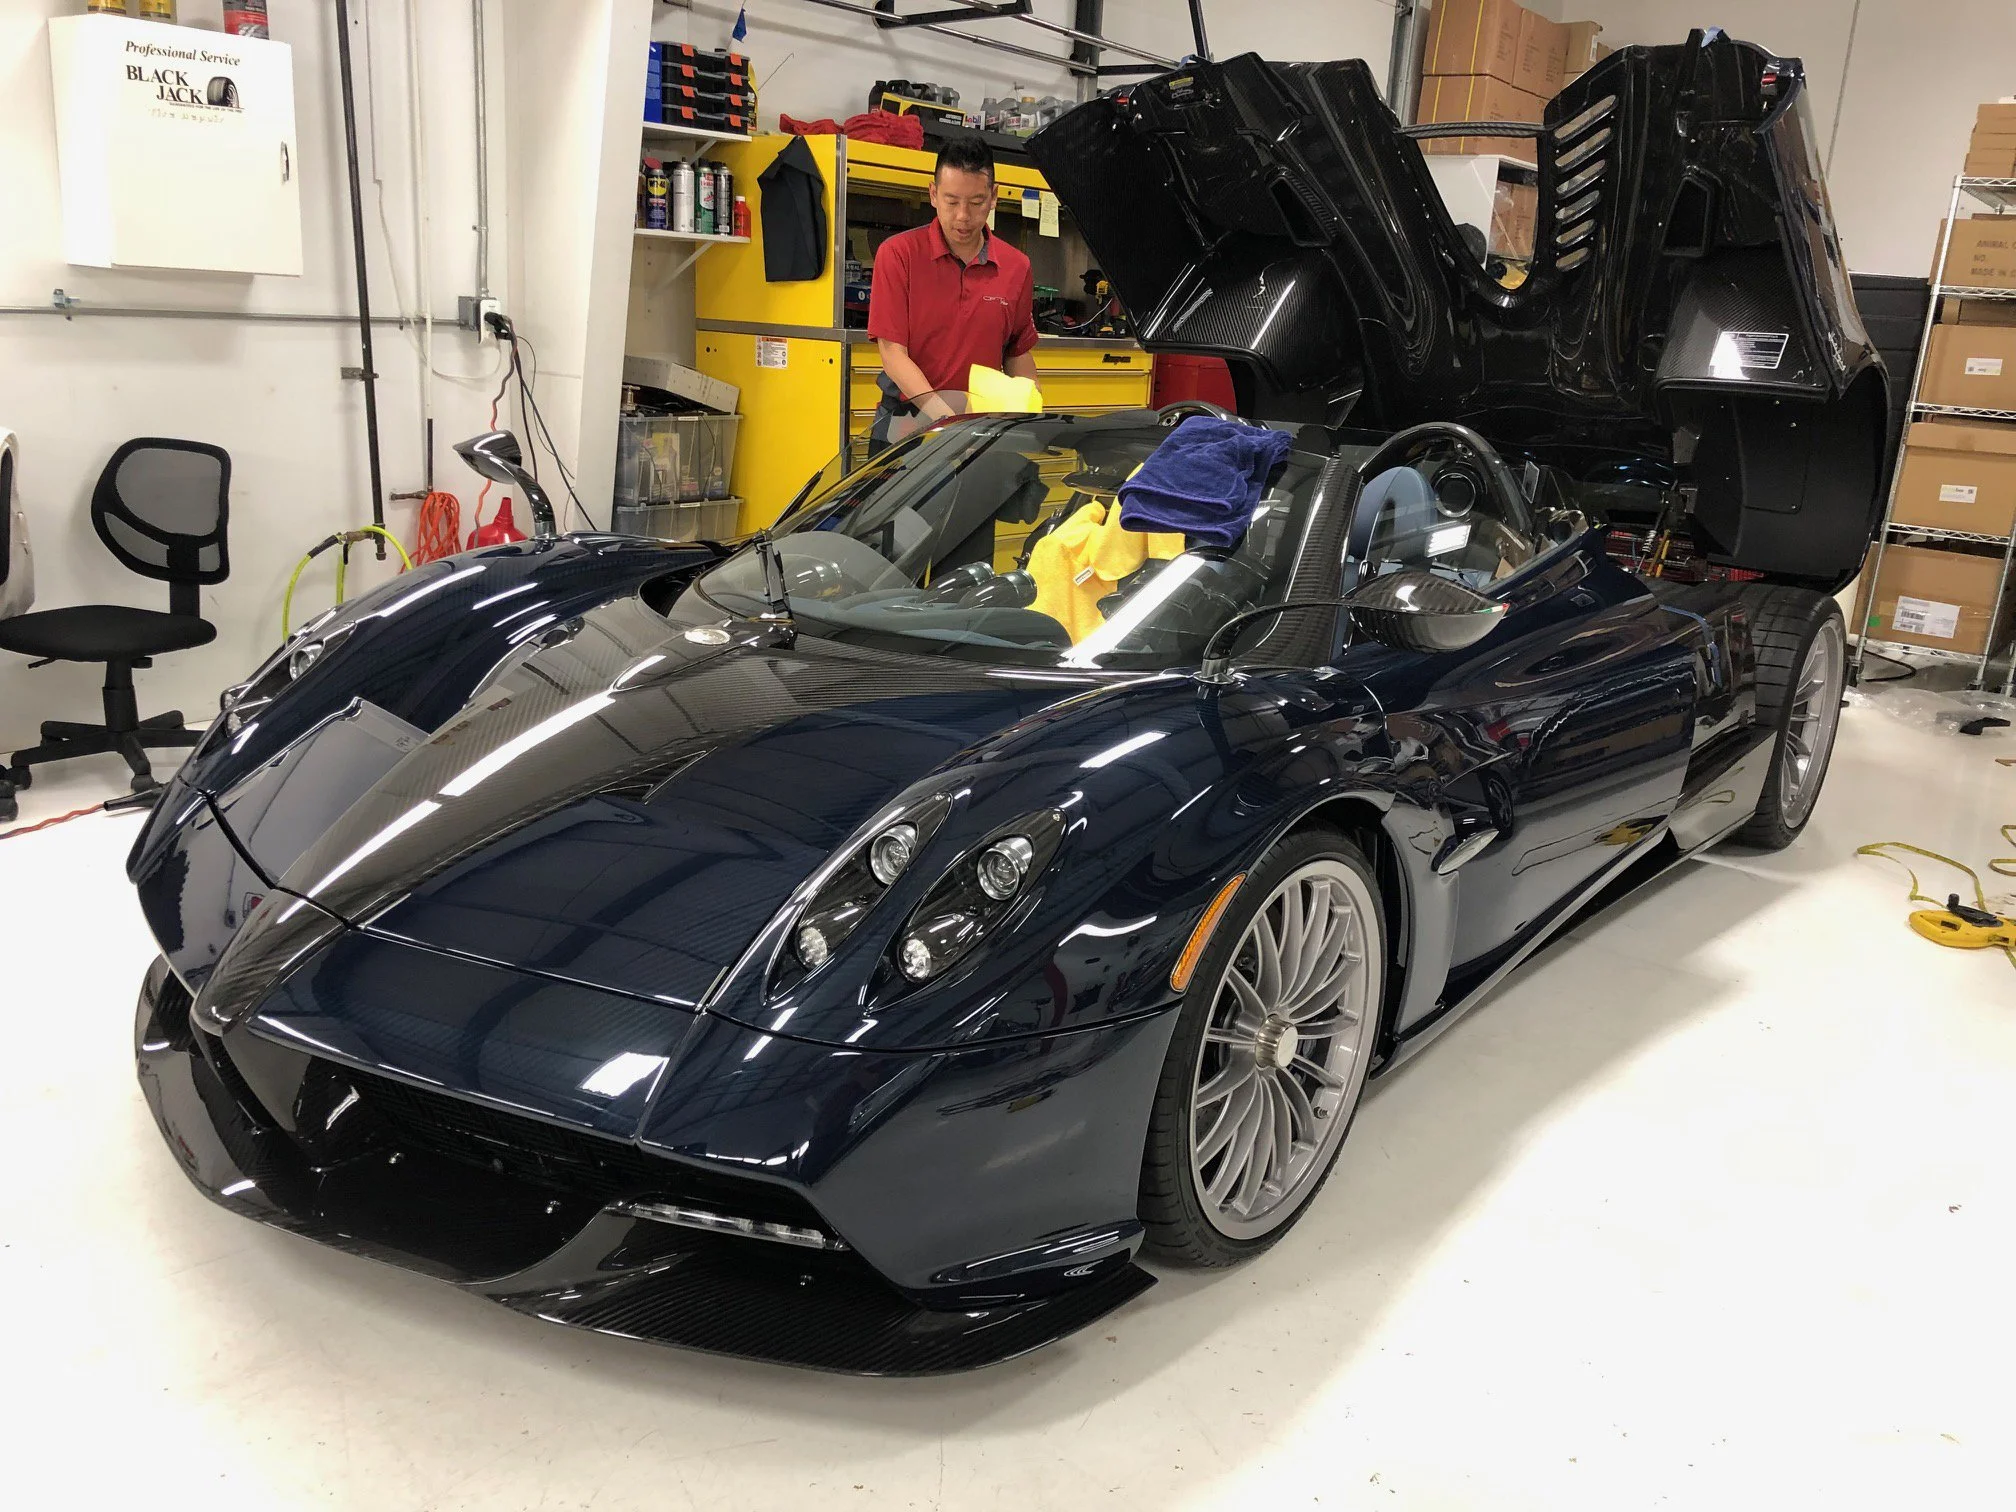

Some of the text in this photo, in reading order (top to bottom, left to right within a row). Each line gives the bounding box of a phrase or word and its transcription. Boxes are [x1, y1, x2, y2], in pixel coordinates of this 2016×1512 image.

[125, 40, 240, 66] Professional Service
[126, 64, 189, 87] BLACK
[156, 85, 204, 105] JACK
